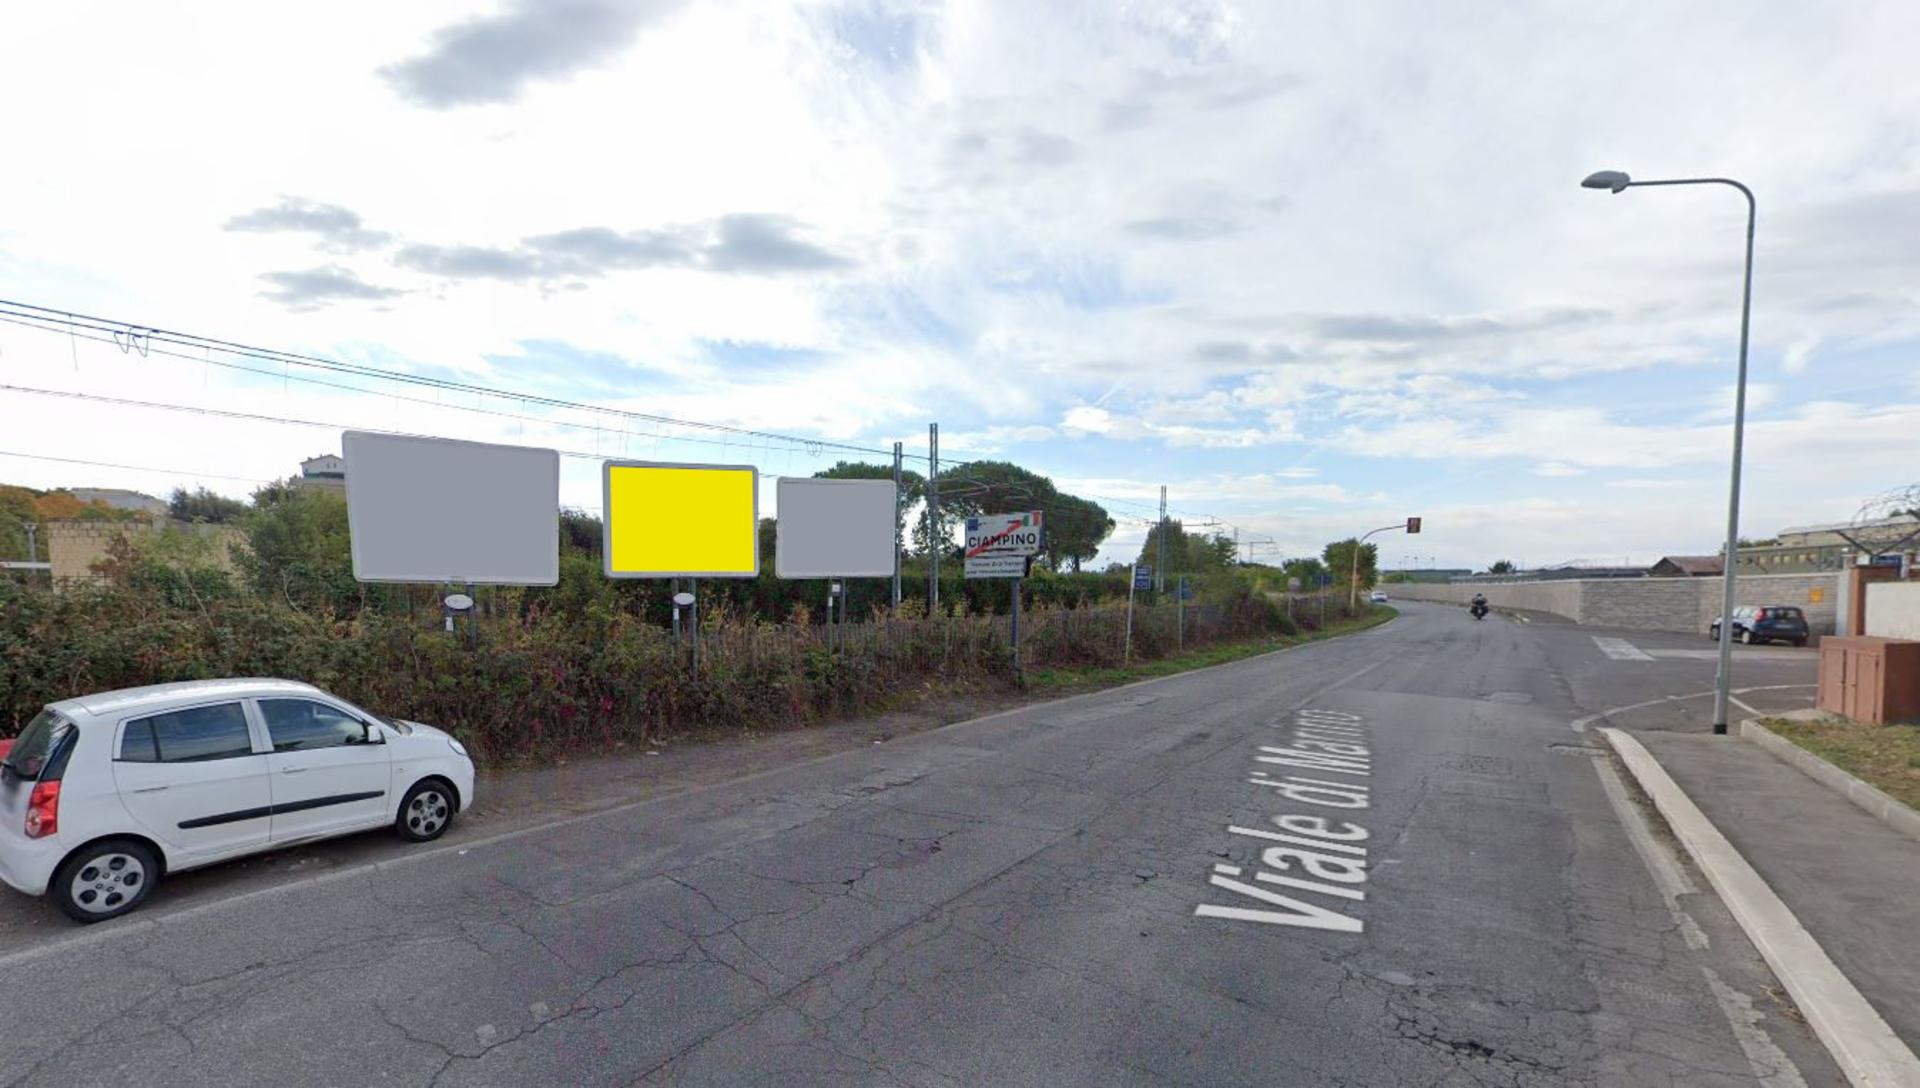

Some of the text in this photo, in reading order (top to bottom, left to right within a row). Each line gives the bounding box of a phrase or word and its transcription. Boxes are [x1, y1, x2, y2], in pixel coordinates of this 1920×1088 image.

[968, 533, 1036, 548] CIAMPINO
[1195, 709, 1371, 933] Viale di Marino
